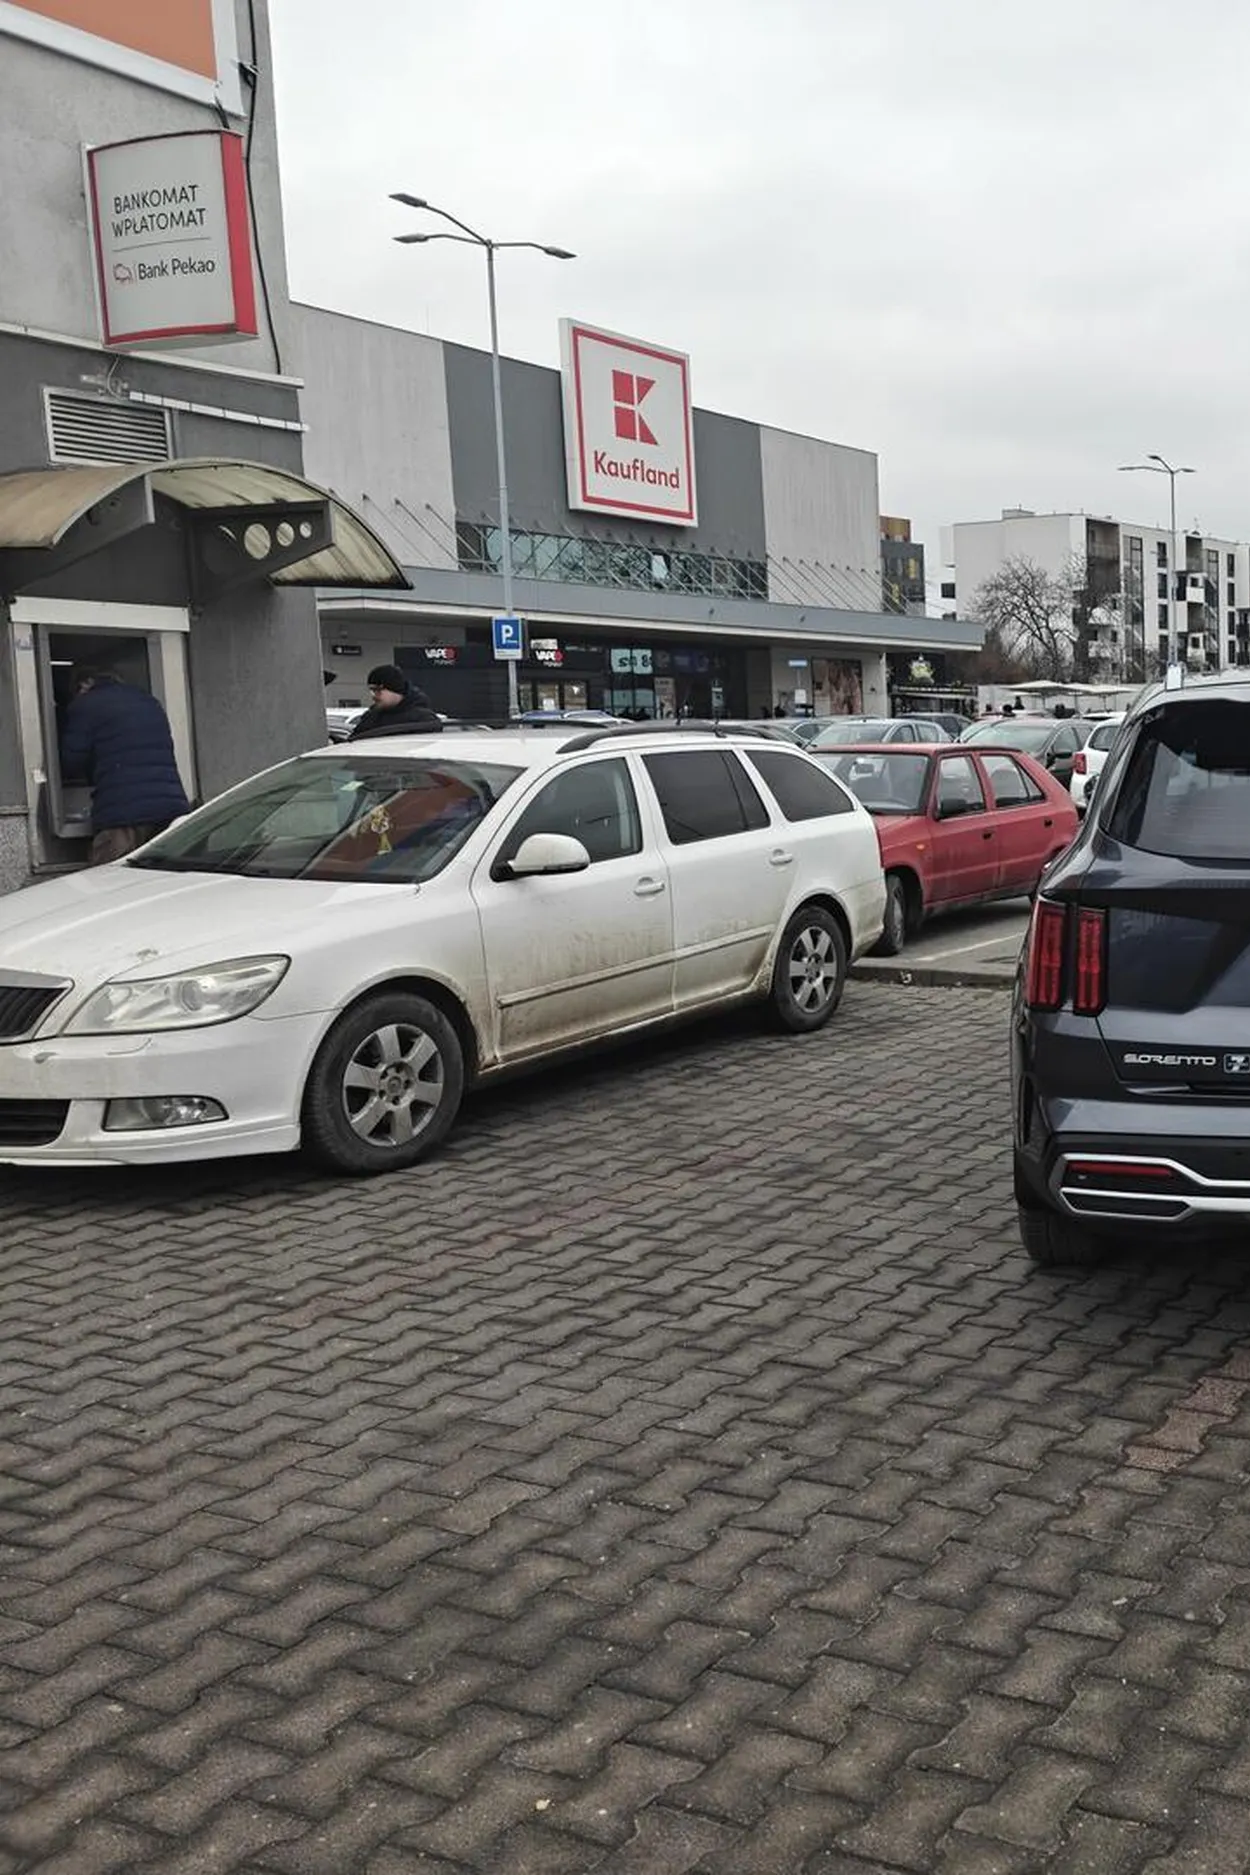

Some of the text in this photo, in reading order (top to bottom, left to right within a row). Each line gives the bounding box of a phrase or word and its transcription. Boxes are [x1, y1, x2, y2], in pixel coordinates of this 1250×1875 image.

[113, 184, 199, 214] BANKOMAT
[111, 208, 206, 237] WPŁATOMAT
[138, 256, 215, 280] Bank Pekao
[593, 450, 680, 489] Kaufland
[1123, 1053, 1217, 1066] SORENTO
